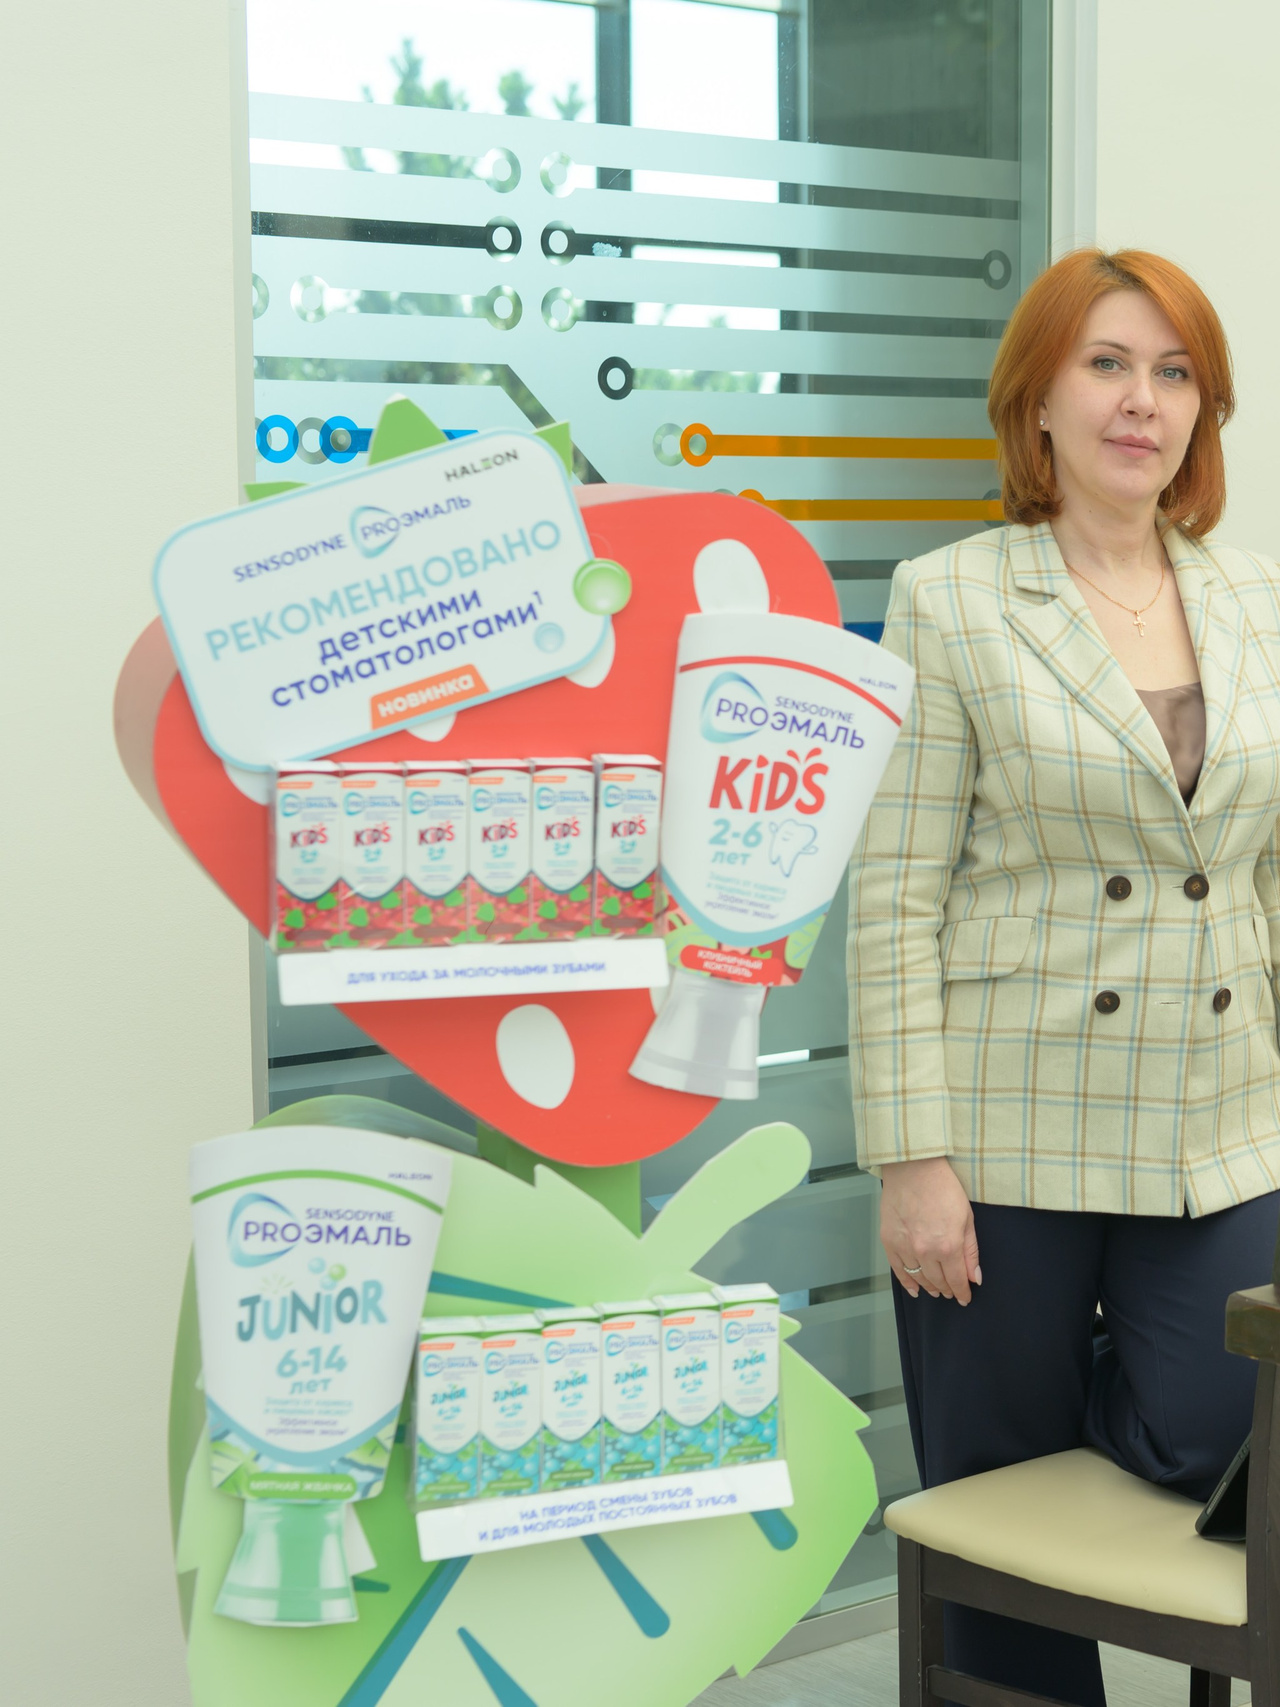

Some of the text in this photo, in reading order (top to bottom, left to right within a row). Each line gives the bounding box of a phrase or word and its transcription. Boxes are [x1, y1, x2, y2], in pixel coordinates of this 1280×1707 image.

[444, 449, 520, 482] HALEON
[233, 496, 472, 582] SENSODYNE PROЭМАЛЬ
[205, 520, 561, 661] РЕКОМЕНДОВАНО
[319, 589, 482, 666] детскими
[715, 697, 866, 750] PROЭМАЛЬ
[775, 695, 855, 725] SENSODYNE
[708, 818, 763, 848] 2-6
[710, 851, 753, 866] лет
[380, 970, 428, 982] УХОДА
[433, 968, 450, 980] ЗА
[306, 1207, 396, 1222] SENSODYNE
[243, 1221, 412, 1247] PROЭМАЛЬ
[275, 1344, 348, 1379] 6-14
[289, 1378, 333, 1395] лет
[491, 1526, 519, 1541] ДЛЯ
[523, 1515, 595, 1535] МОЛОДЫХ
[599, 1502, 692, 1521] ПОСТОЯННЫХ
[696, 1493, 738, 1509] ЗУБОВ
[520, 1486, 694, 1521] НА ПЕРИОД СМЕНЫ ЗУБОВ
